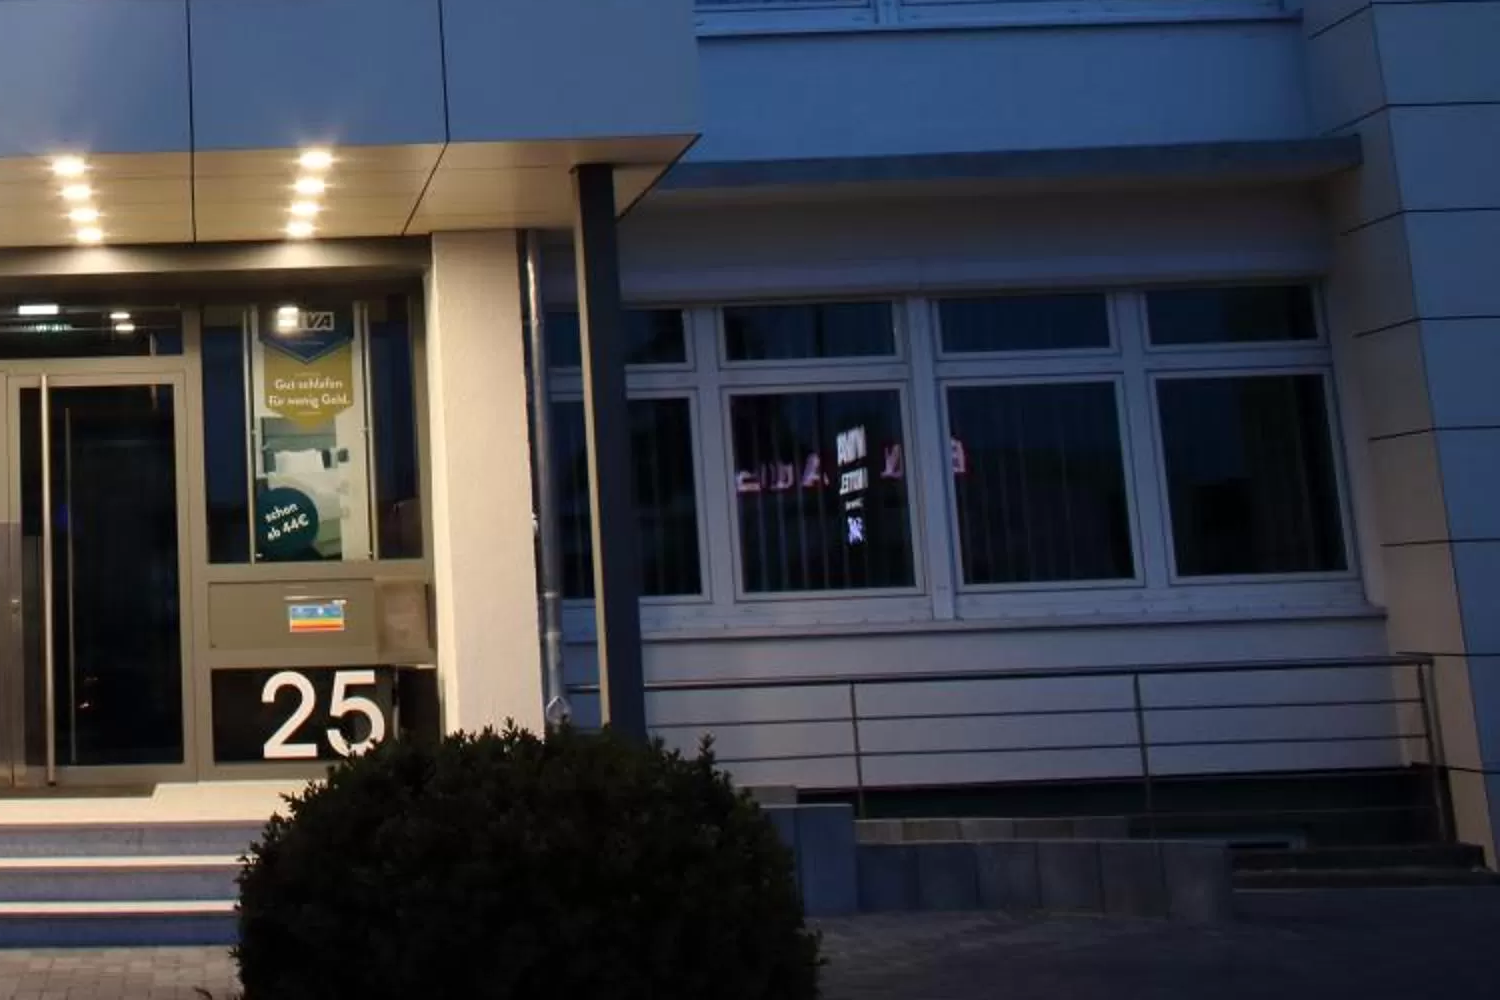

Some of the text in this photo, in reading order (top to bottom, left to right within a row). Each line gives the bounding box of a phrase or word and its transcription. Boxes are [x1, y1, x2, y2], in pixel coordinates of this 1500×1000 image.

[275, 376, 343, 390] Gut schlafen
[265, 503, 298, 522] schon
[267, 527, 281, 541] ab
[261, 669, 385, 759] 25
